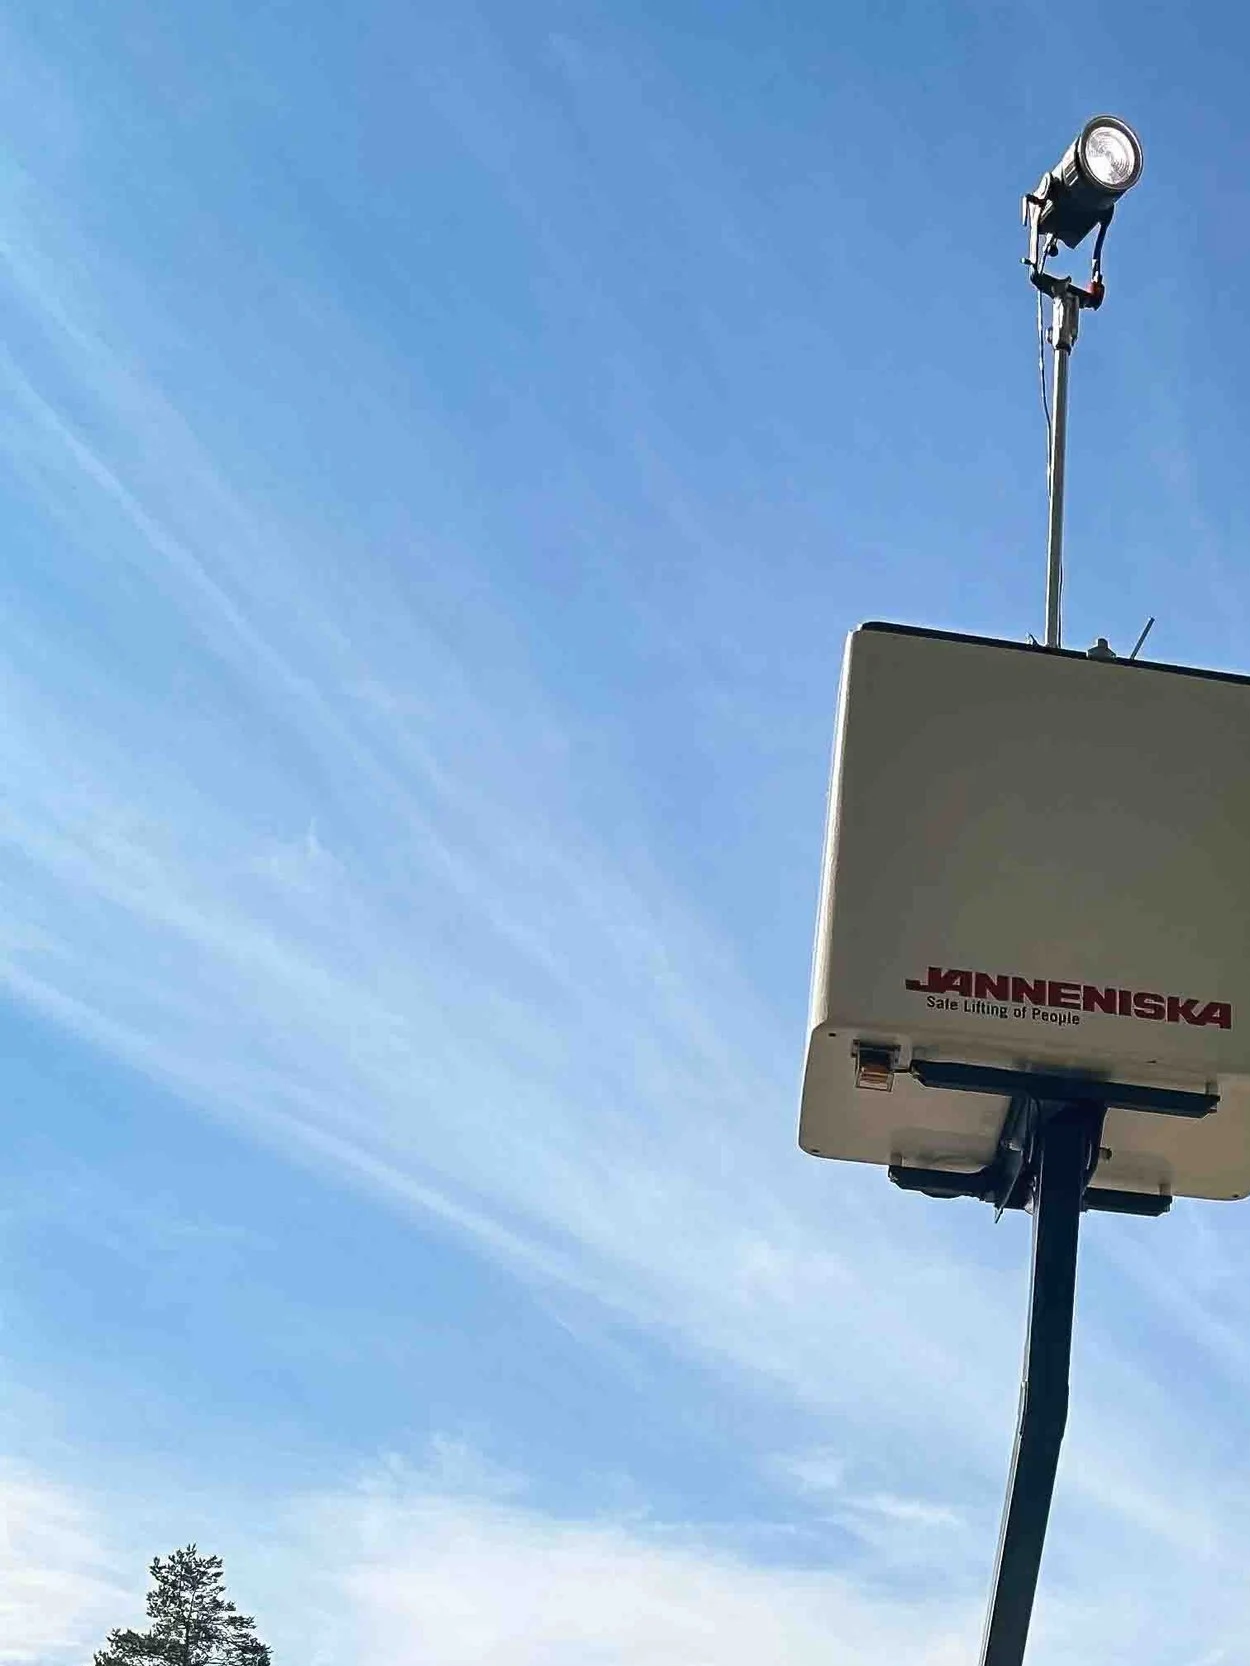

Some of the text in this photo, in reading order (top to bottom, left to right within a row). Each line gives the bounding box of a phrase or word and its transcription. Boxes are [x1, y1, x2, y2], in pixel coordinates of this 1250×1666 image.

[905, 966, 1232, 1030] JANNENISKA
[926, 996, 1081, 1026] Safe Lifting of People
